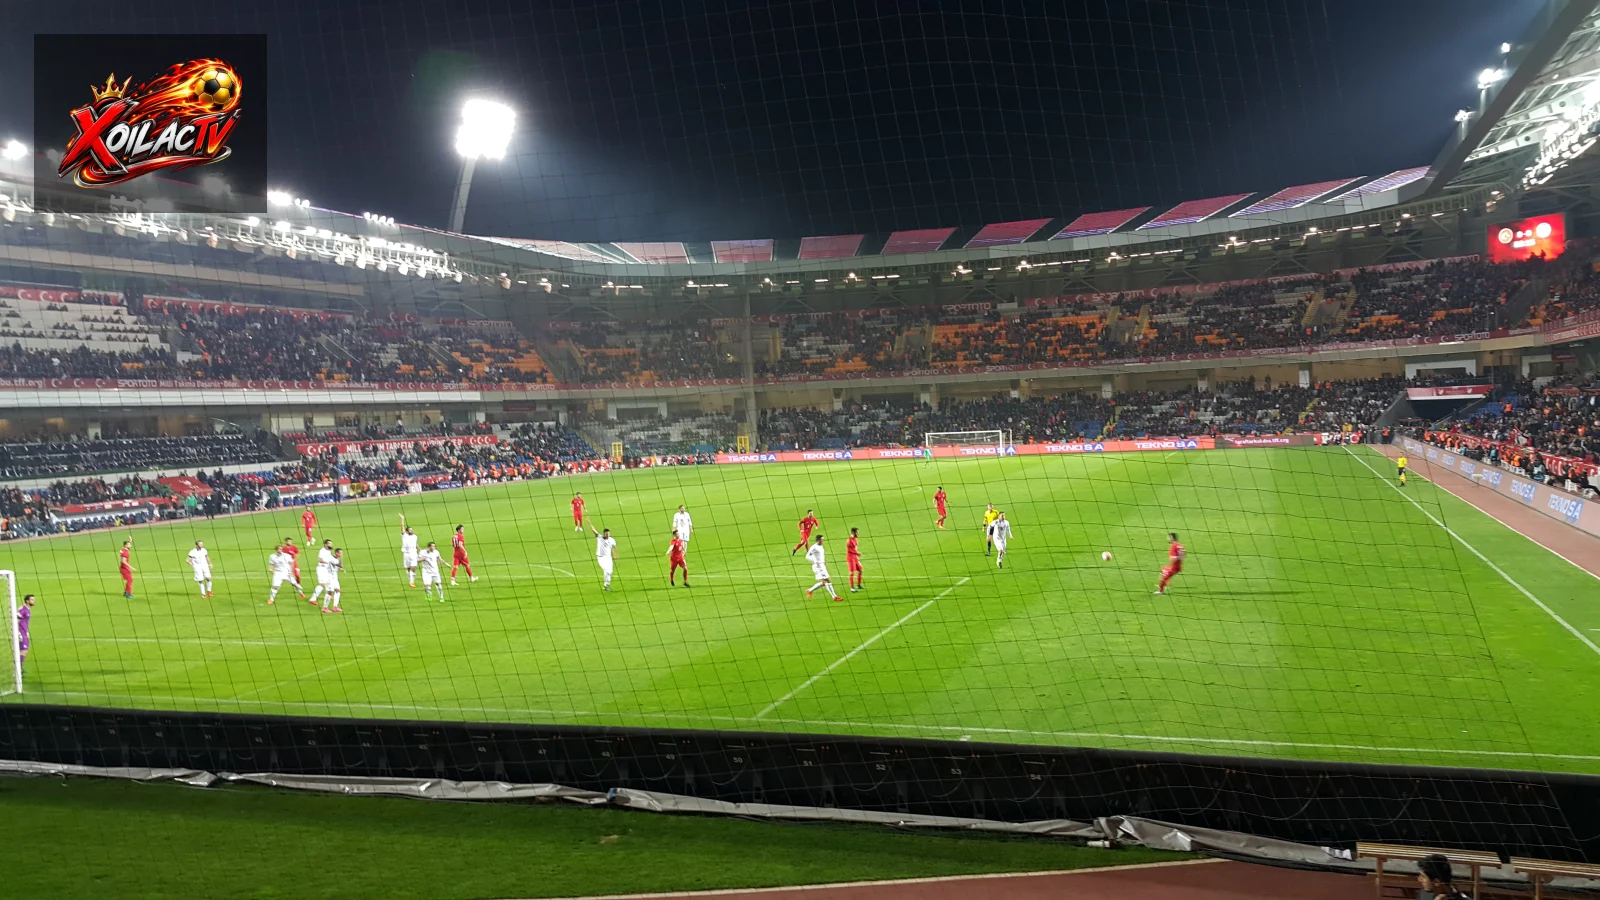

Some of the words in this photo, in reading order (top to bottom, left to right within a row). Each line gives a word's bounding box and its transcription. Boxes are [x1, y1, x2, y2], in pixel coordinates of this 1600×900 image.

[1455, 332, 1490, 341] SPORTOTO
[118, 379, 157, 387] SPORTOTO
[1045, 442, 1105, 452] TEKNOSA
[1135, 440, 1198, 449] TEKNOSA
[728, 453, 776, 462] TEKNOSA
[802, 451, 853, 460] TEKNOSA
[1548, 494, 1583, 520] TEKNOSA
